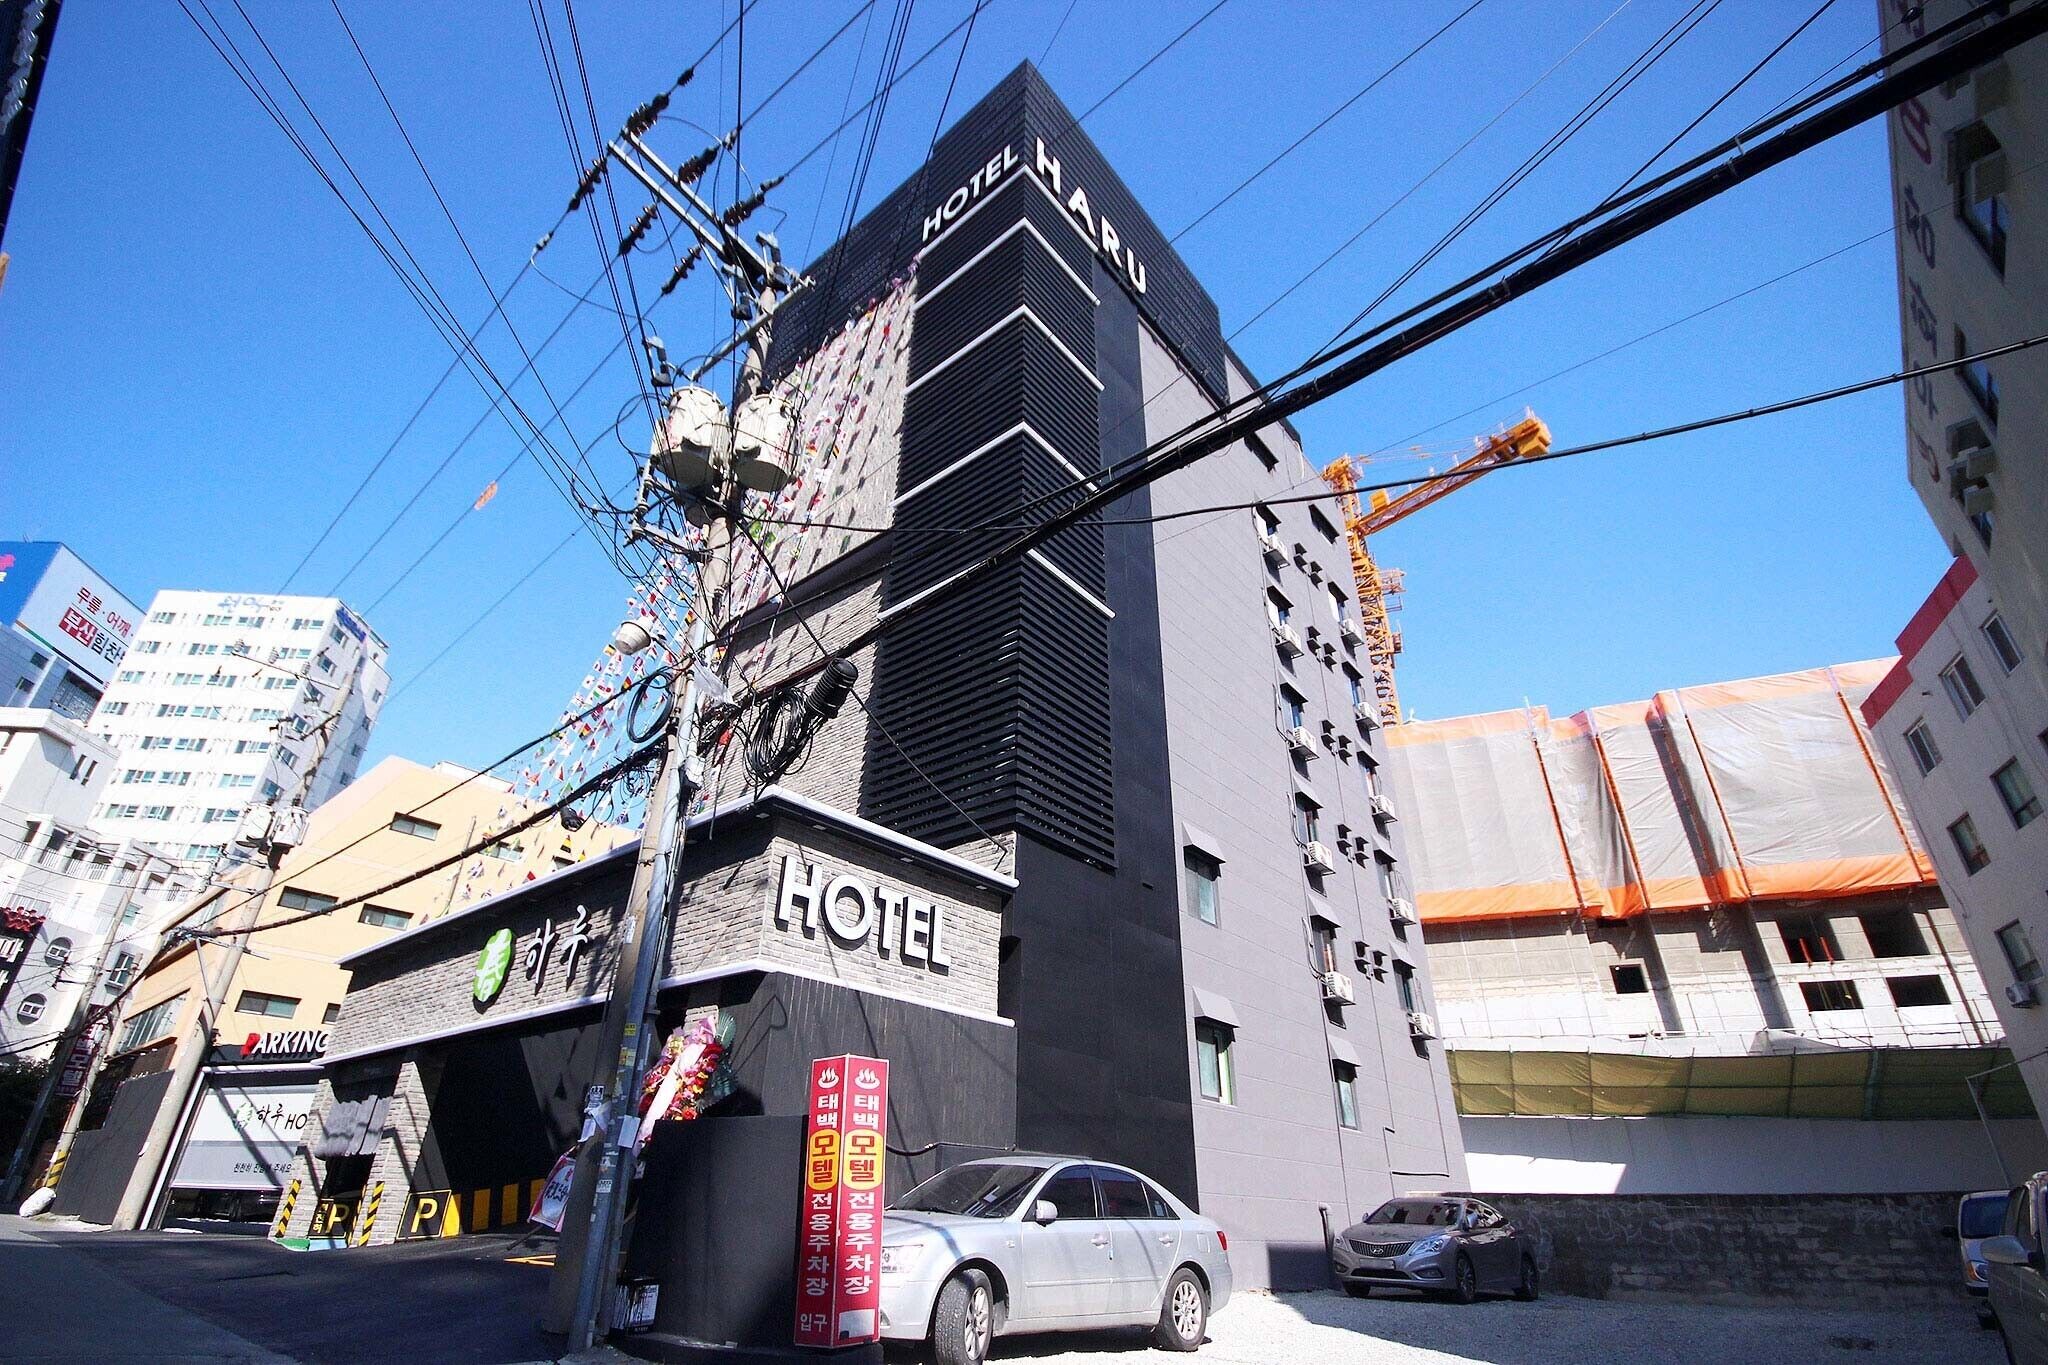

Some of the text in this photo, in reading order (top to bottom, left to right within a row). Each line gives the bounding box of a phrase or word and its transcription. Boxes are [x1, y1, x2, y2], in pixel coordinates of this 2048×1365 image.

[922, 144, 1018, 242] HOTEL
[1036, 136, 1147, 294] HARU
[60, 607, 127, 667] 부산힘찬
[775, 855, 952, 972] HOTEL
[525, 904, 588, 985] 하루
[241, 1030, 331, 1056] PARKING
[256, 1103, 284, 1128] 하루
[325, 1203, 350, 1234] P
[410, 1197, 438, 1233] P
[800, 1313, 828, 1333] 입구
